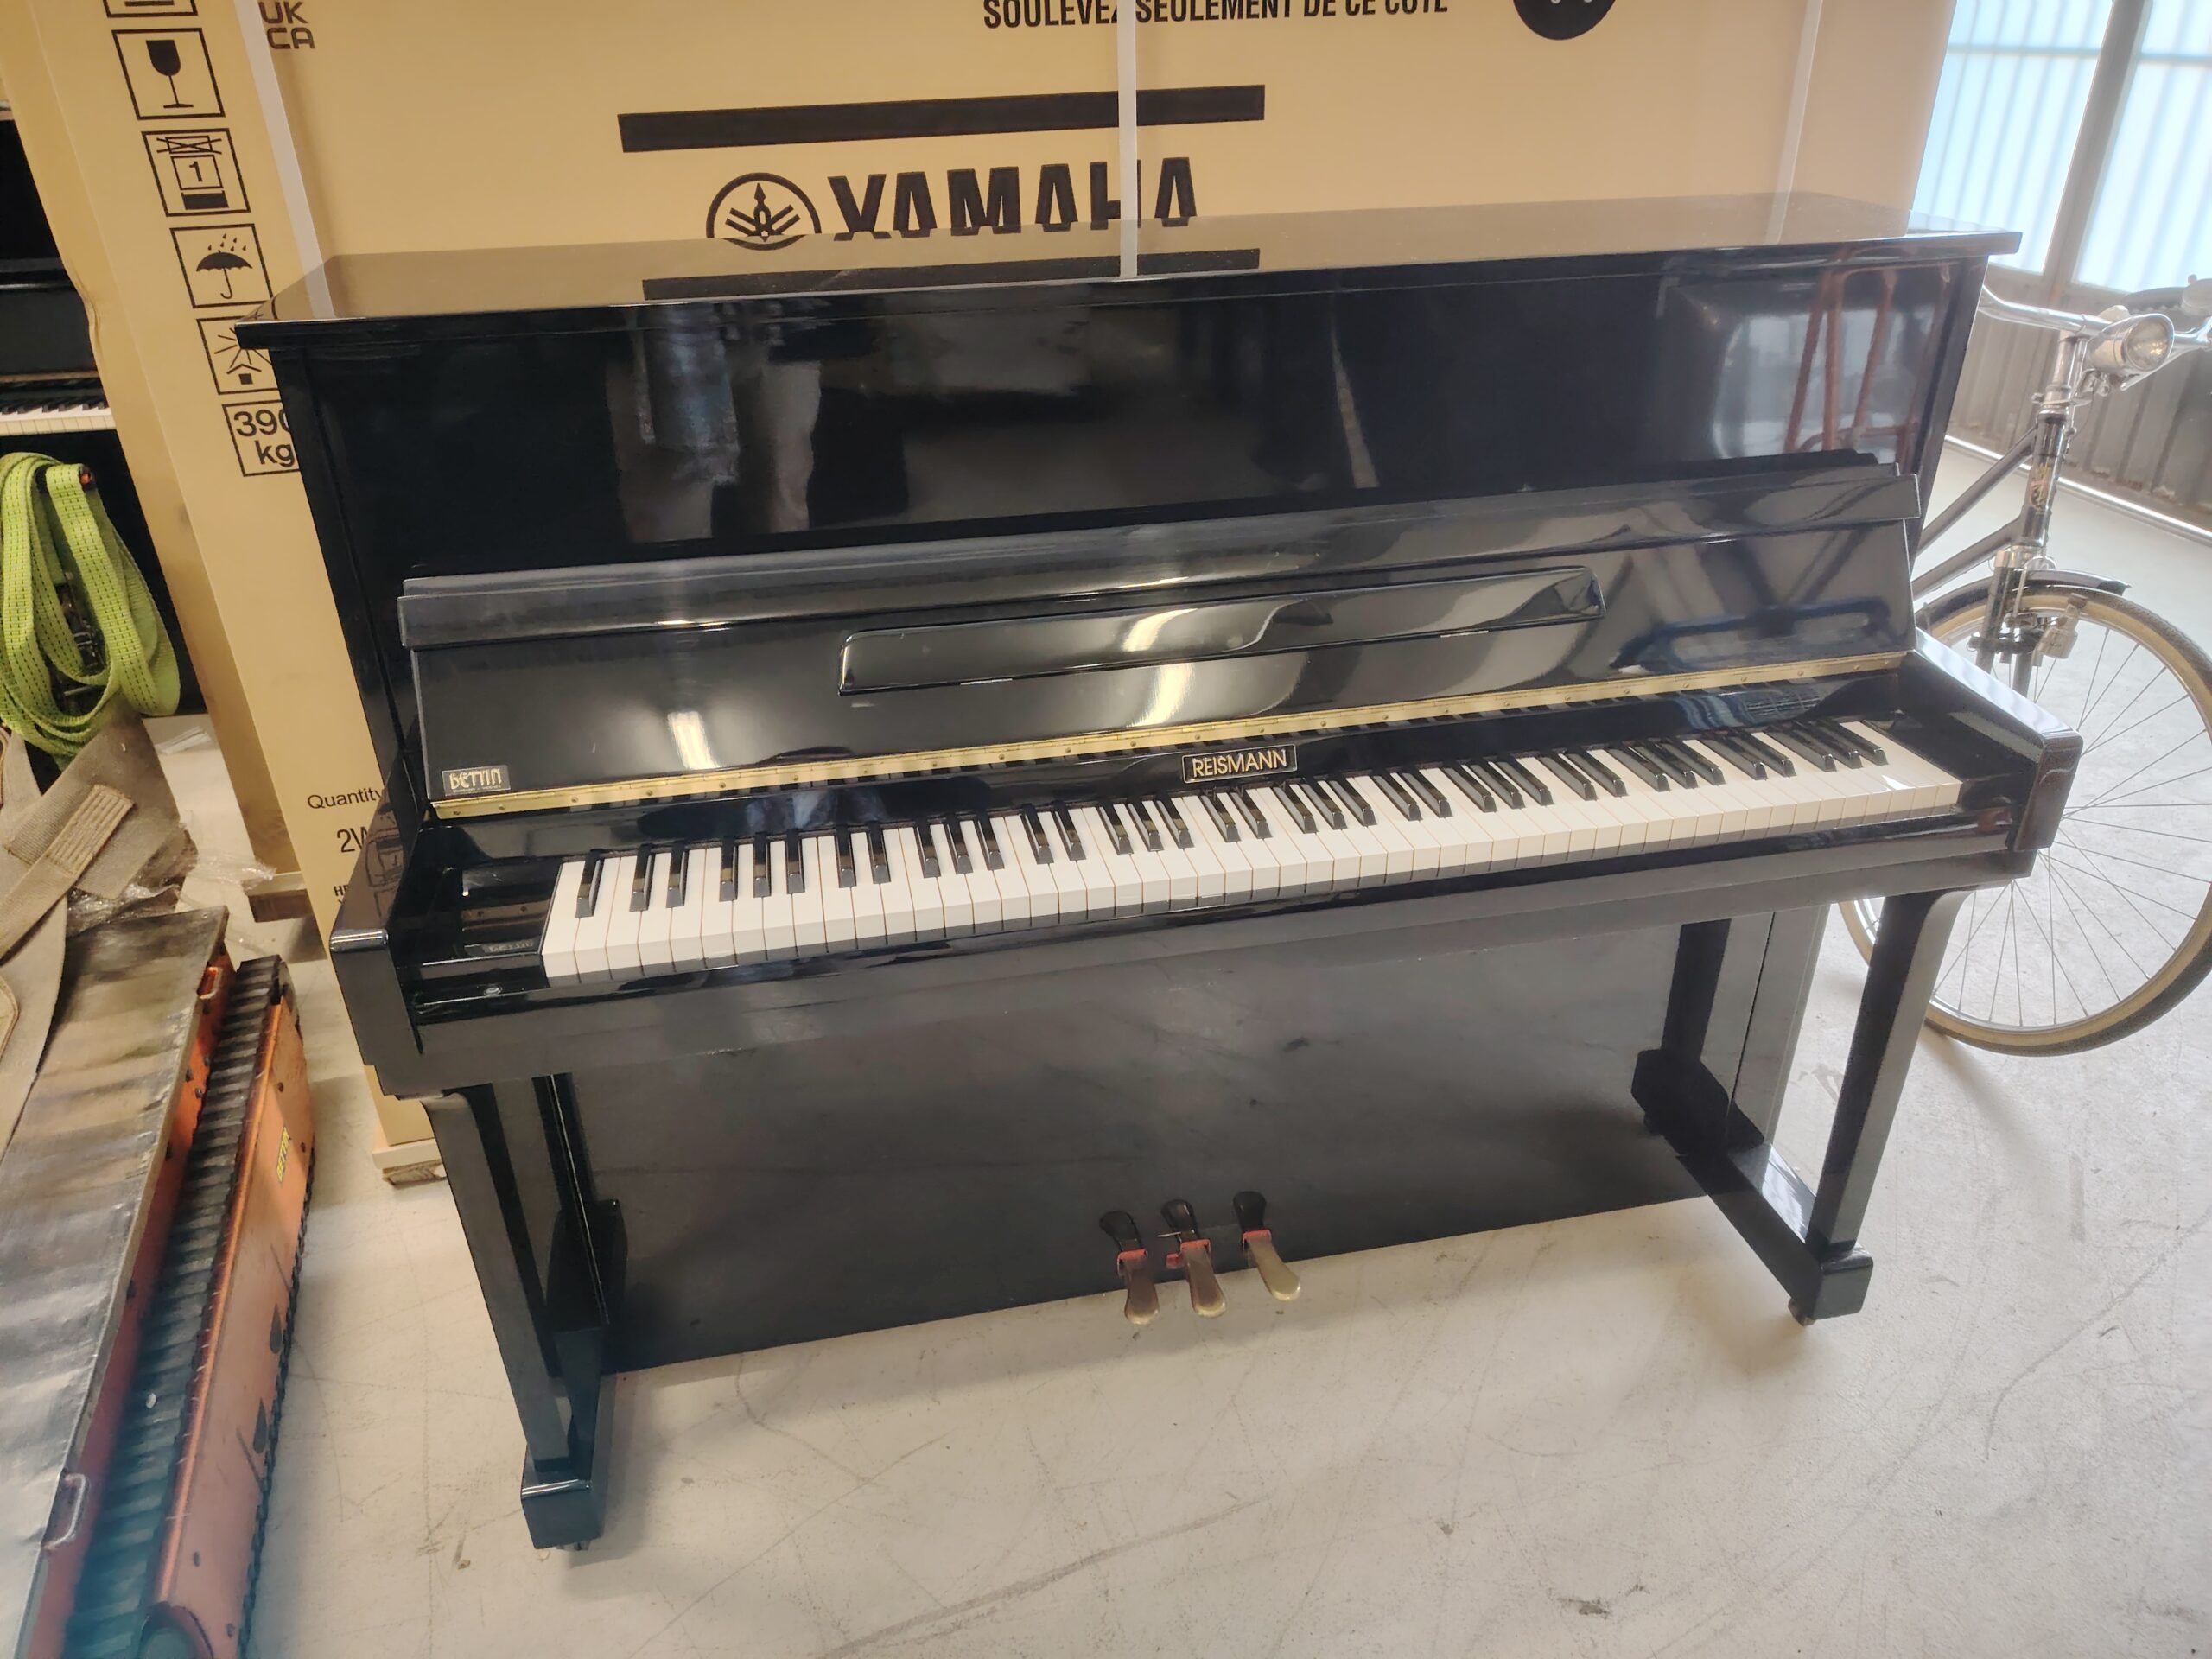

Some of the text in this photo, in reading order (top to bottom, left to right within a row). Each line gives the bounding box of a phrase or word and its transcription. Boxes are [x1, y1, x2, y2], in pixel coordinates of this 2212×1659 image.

[258, 0, 308, 24] UK
[983, 0, 1118, 29] SOULEVE
[266, 27, 315, 49] CA
[827, 156, 1198, 237] YAMAHA
[255, 440, 296, 467] kg
[1192, 748, 1287, 778] REISMANN
